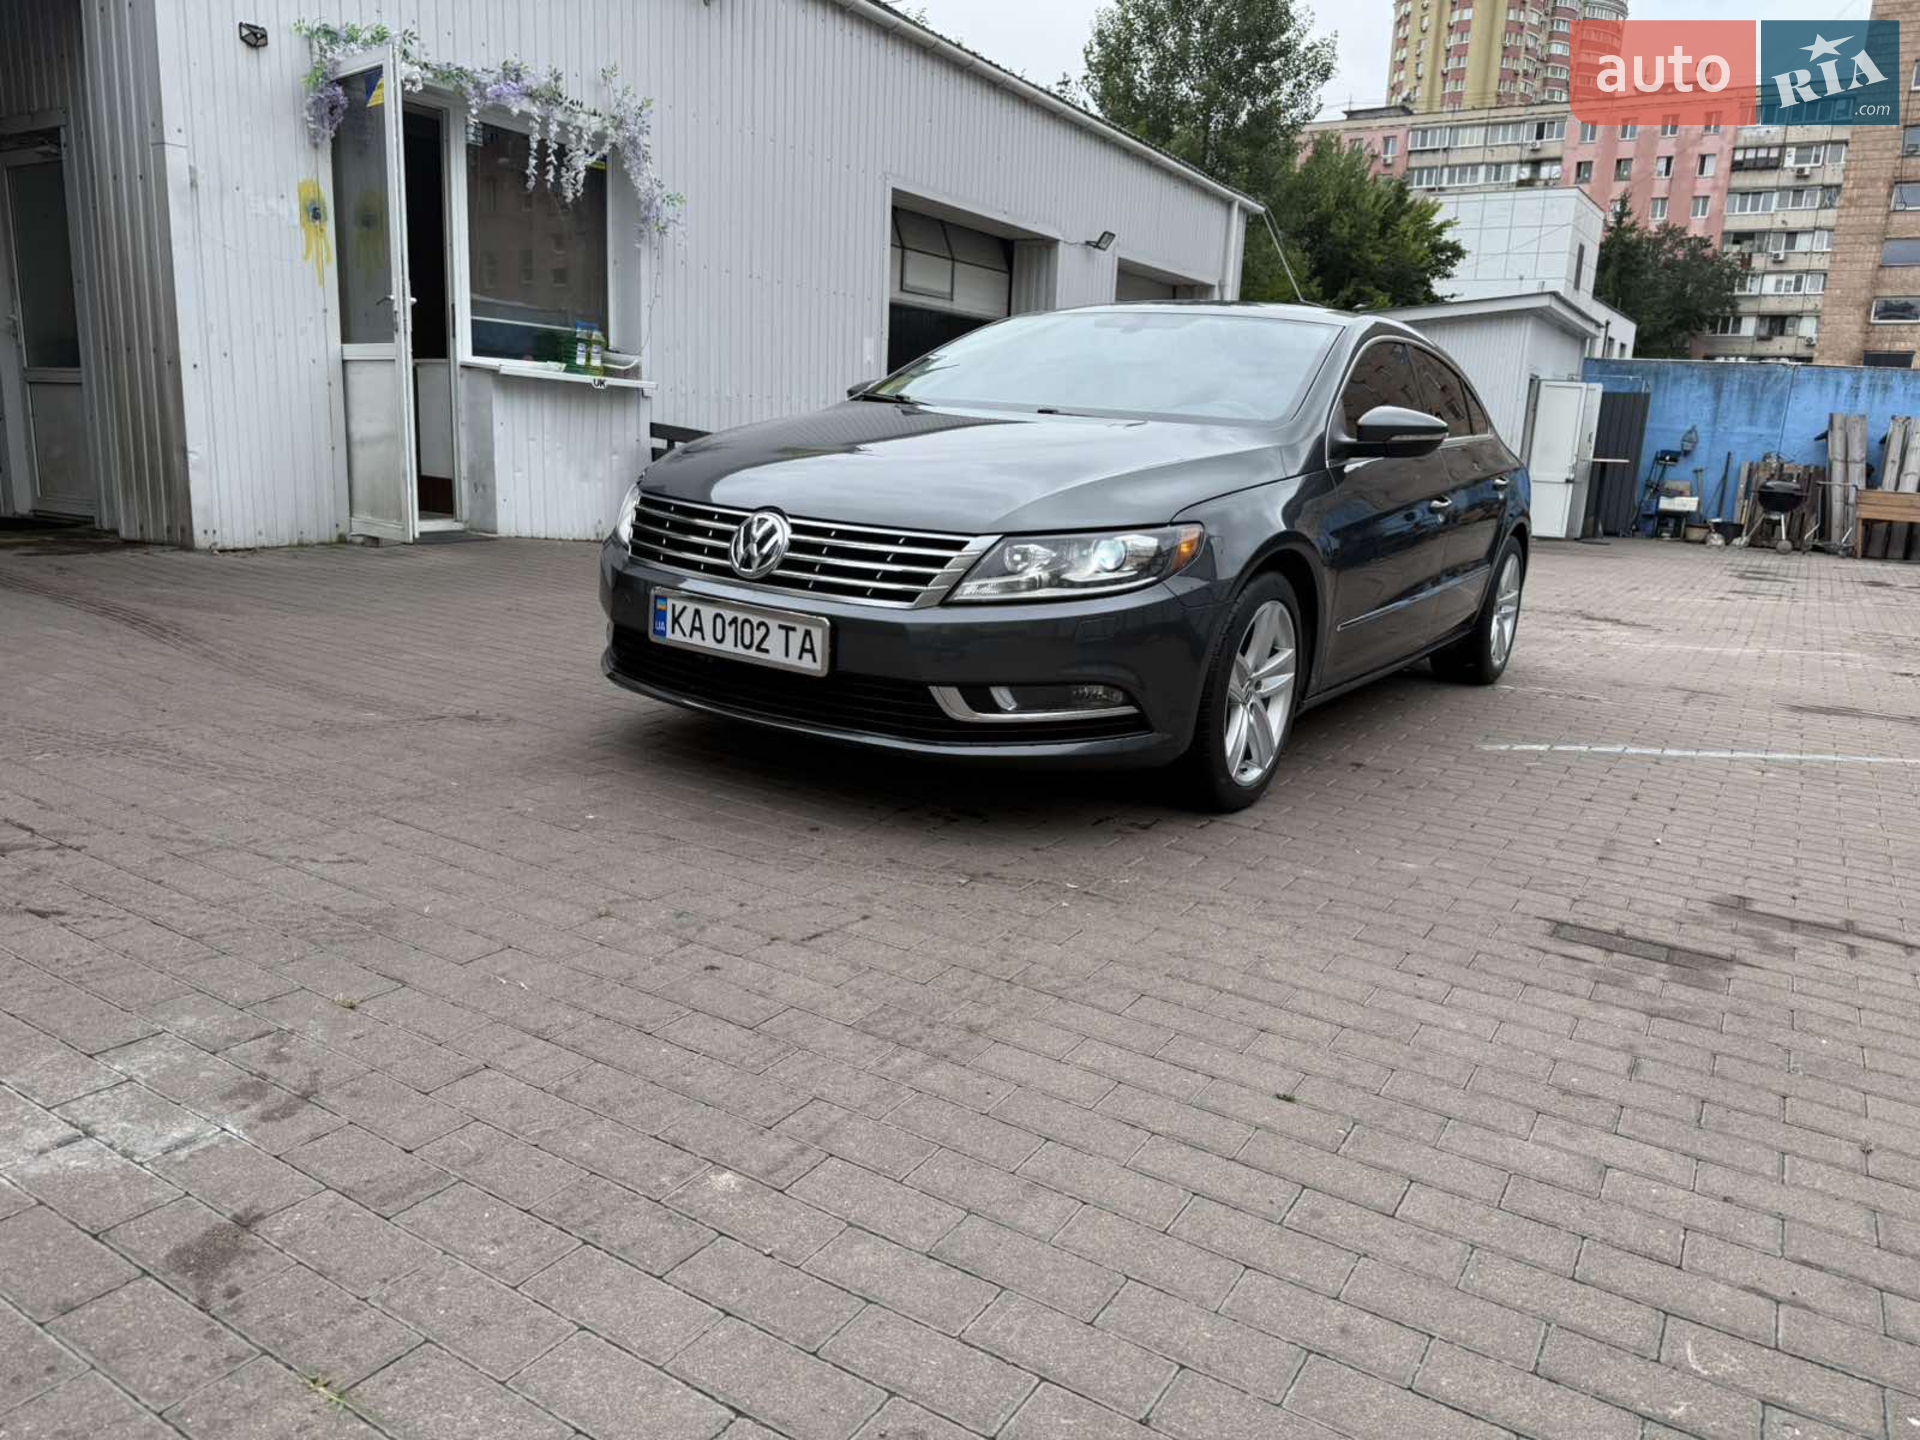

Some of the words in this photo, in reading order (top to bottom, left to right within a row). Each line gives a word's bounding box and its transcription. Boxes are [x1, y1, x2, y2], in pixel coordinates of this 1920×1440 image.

[655, 620, 666, 631] UA
[671, 603, 706, 641] KA
[712, 612, 770, 654] 0102
[777, 623, 817, 663] TA
